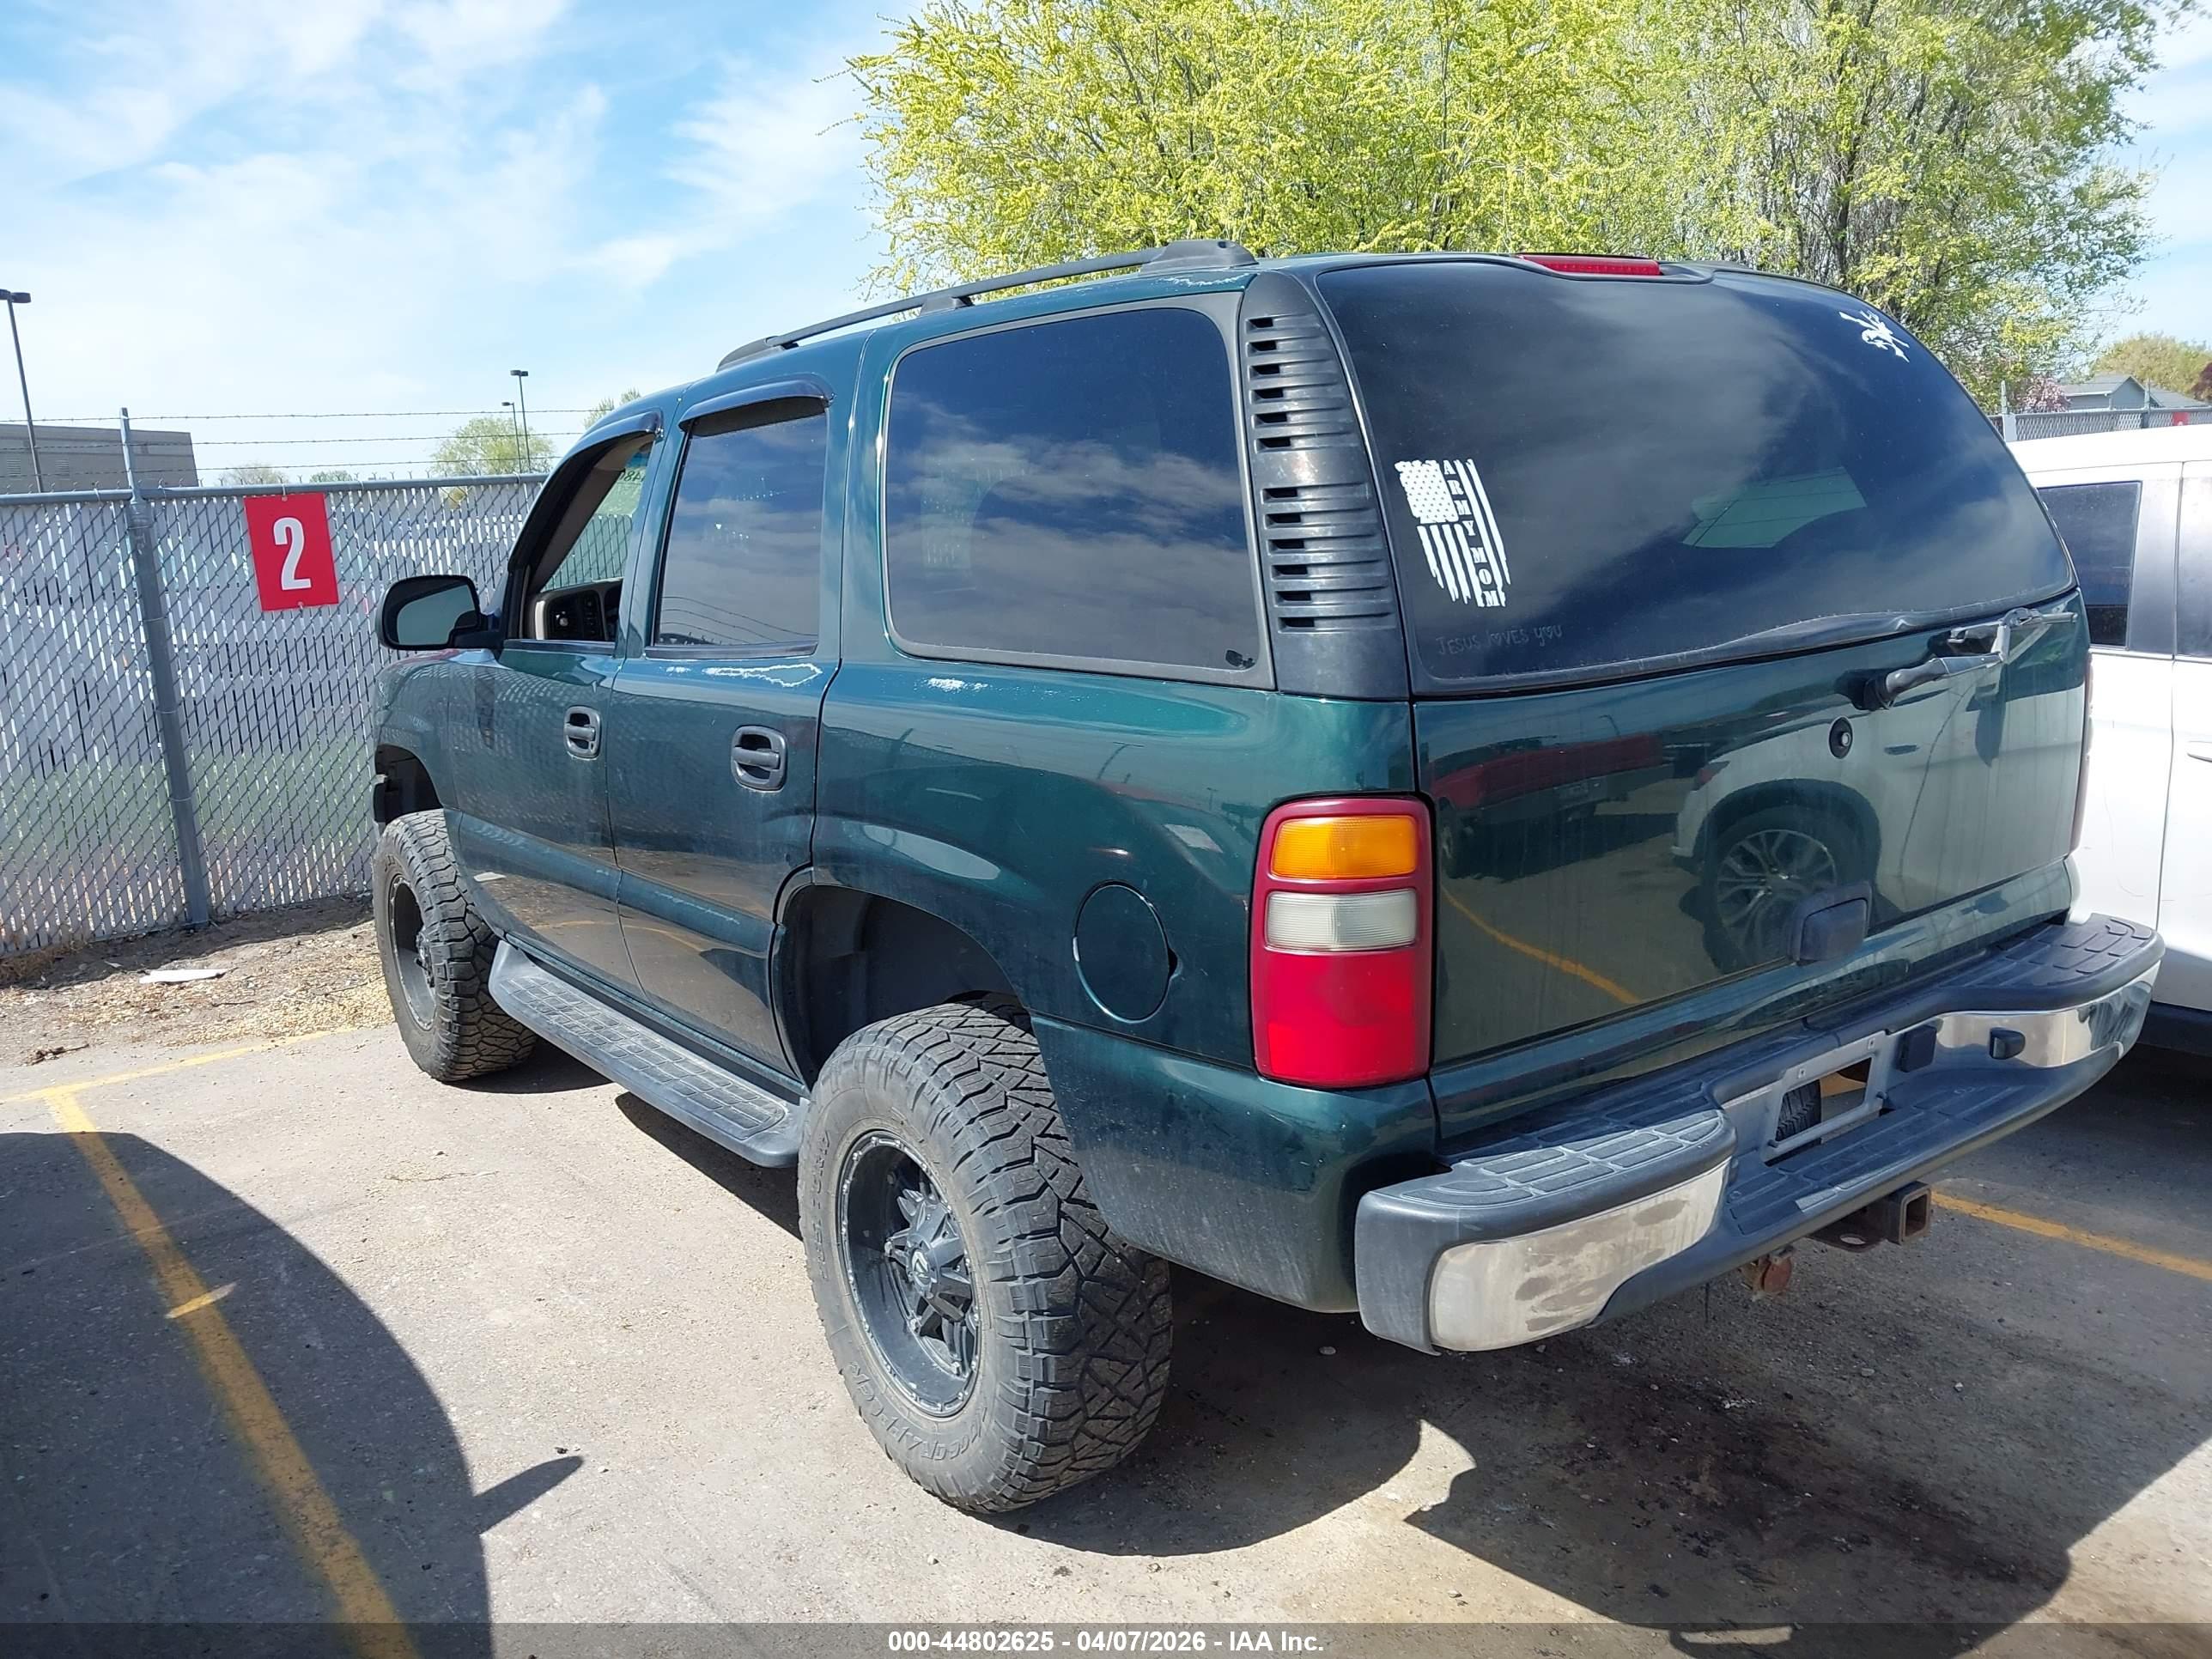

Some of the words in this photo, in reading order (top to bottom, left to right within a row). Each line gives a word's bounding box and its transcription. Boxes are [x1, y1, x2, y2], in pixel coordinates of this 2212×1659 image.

[273, 517, 312, 591] 2
[1443, 459, 1476, 537] ARMY
[1470, 547, 1500, 606] MOM
[1435, 634, 1481, 655] JESUS
